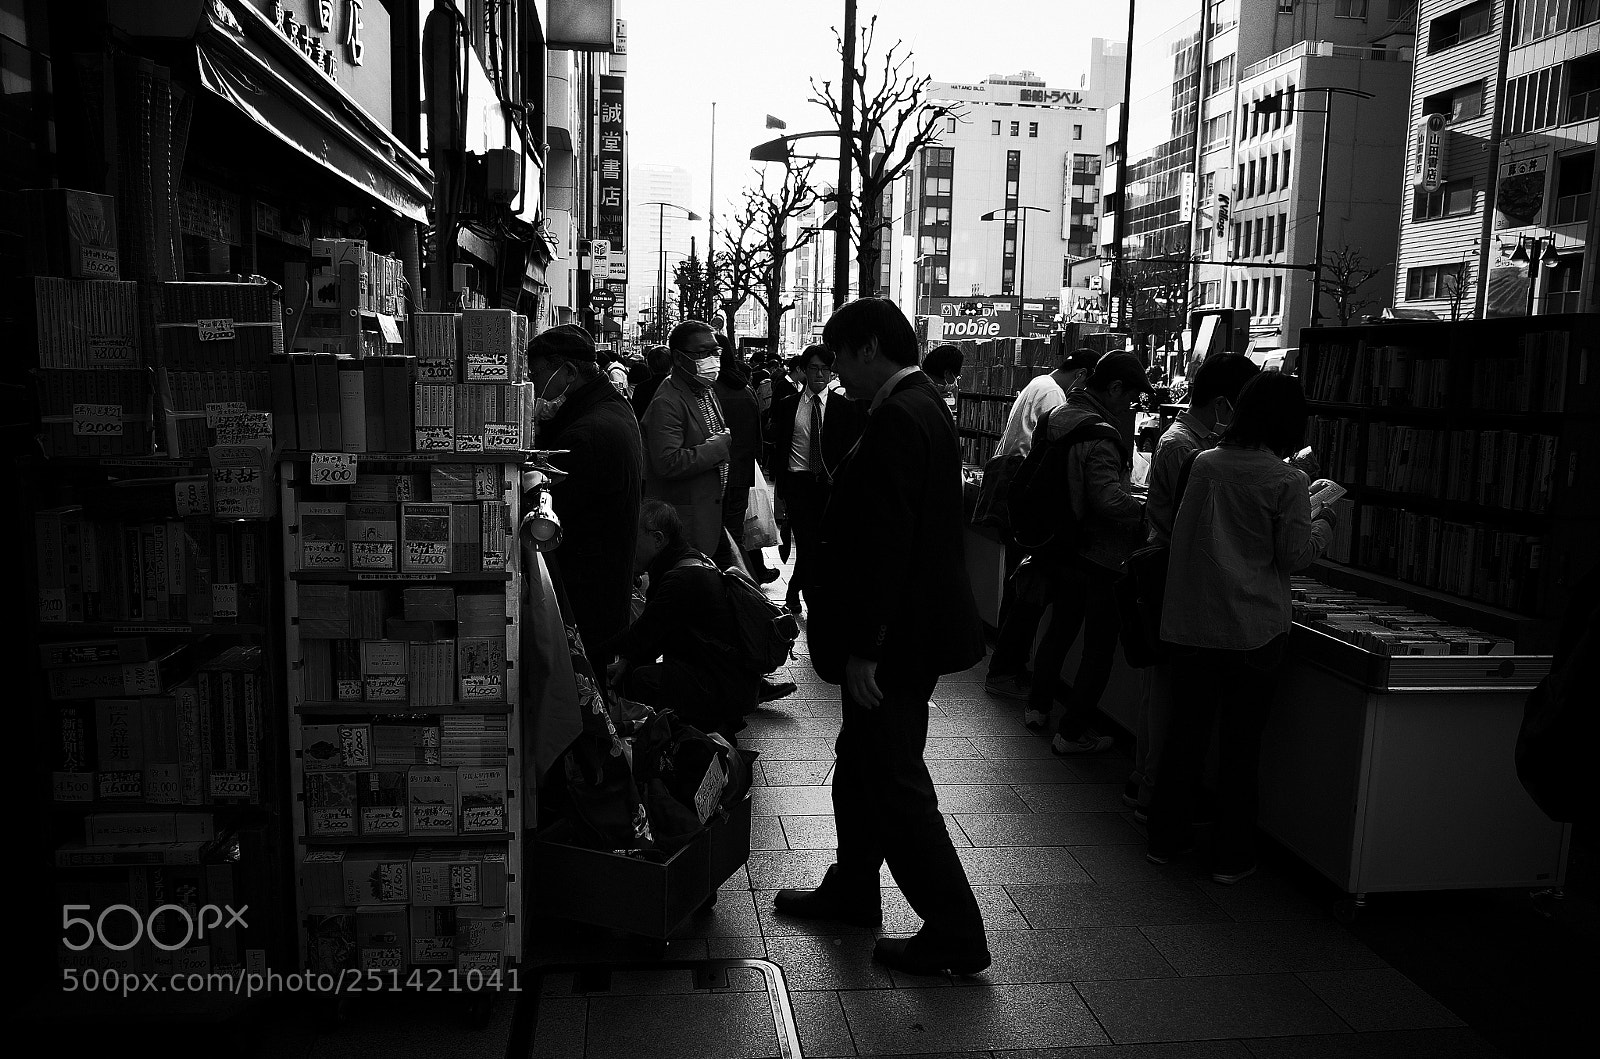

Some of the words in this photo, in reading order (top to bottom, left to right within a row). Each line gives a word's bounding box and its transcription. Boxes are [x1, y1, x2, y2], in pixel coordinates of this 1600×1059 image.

[601, 88, 622, 208] 一誠堂書店
[1426, 133, 1440, 181] 山田書店
[86, 258, 116, 273] ¥6,000
[942, 318, 1000, 337] mobile
[471, 364, 506, 377] ¥4,000
[466, 687, 498, 697] ¥4,000
[109, 711, 130, 760] 広辞苑
[468, 816, 499, 828] ¥4,000
